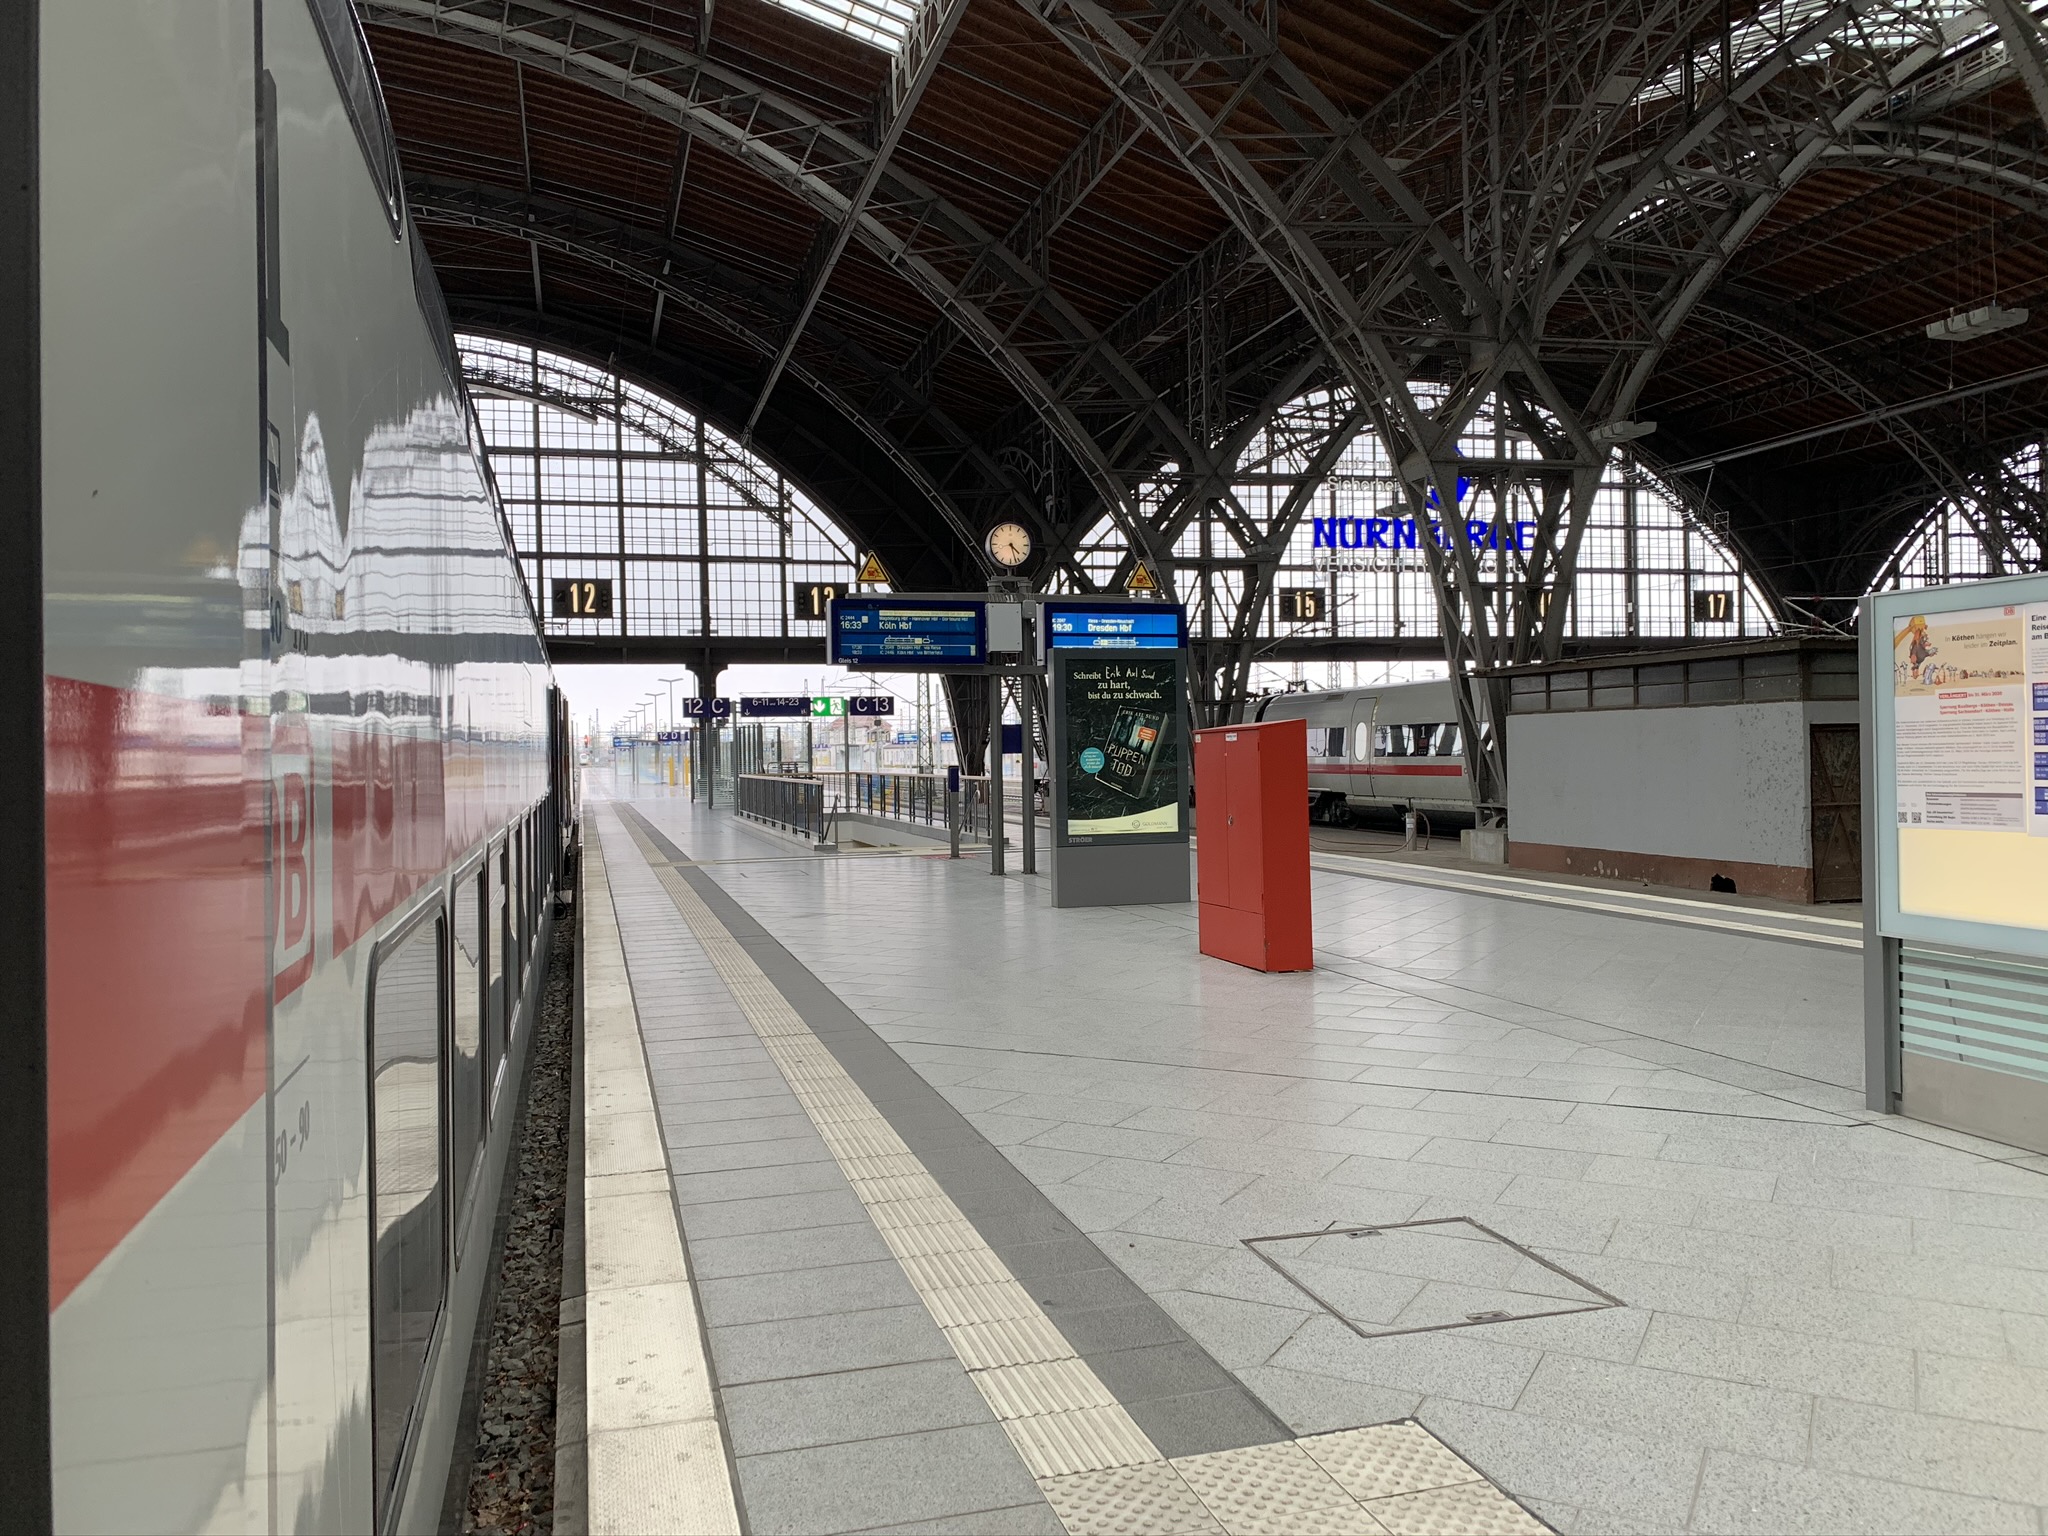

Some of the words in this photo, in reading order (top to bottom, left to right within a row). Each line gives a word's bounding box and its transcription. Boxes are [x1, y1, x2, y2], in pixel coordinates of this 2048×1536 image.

[570, 582, 596, 614] 12
[1295, 591, 1315, 618] 15
[1708, 594, 1726, 618] 17
[840, 621, 862, 629] 16:33
[879, 621, 897, 630] Köln
[899, 621, 912, 630] Hbf
[1088, 624, 1118, 632] Dresden
[1120, 624, 1132, 632] Hbf
[1951, 634, 1975, 642] Köthen
[1975, 632, 1997, 641] hängen
[1989, 639, 2018, 648] Zeitplan.
[1073, 671, 1101, 680] Schreibt
[1105, 665, 1121, 679] Erik
[1126, 667, 1138, 678] Axl
[1141, 669, 1155, 680] Sund
[1110, 680, 1131, 690] hart,
[1125, 690, 1162, 699] schwach.
[685, 698, 703, 713] 12
[712, 698, 724, 713] C
[752, 698, 769, 706] 6-11
[776, 698, 799, 706] 14-23
[856, 697, 868, 712] C
[873, 697, 889, 712] 13
[659, 732, 668, 740] 12
[671, 732, 678, 740] D
[1420, 725, 1426, 738] 1
[1106, 743, 1147, 766] PUPPEN
[1110, 758, 1133, 777] TOD
[1068, 836, 1093, 844] STRÖER
